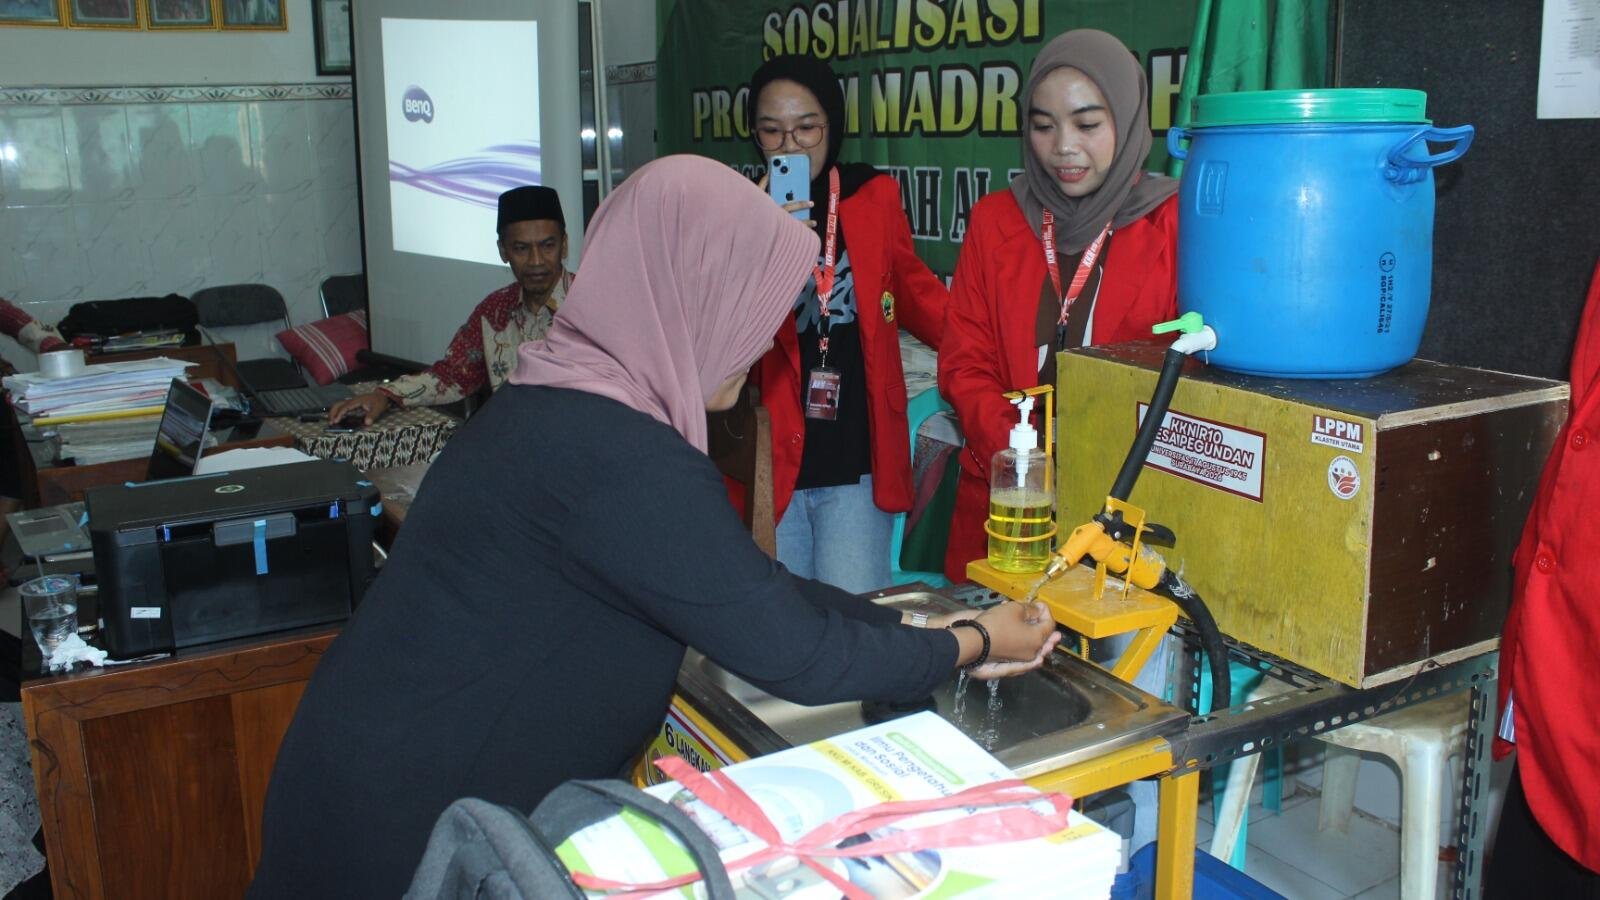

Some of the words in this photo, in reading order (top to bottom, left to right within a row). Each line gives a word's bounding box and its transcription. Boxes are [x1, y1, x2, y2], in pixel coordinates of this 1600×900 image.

[762, 0, 1041, 60] SOSIALISASI
[692, 76, 860, 139] PROM
[871, 54, 1188, 133] MADRH
[1314, 435, 1340, 446] KLASTER
[1341, 441, 1360, 450] UTAMA
[1315, 416, 1361, 441] LPPM
[1155, 427, 1178, 446] ESA
[1179, 434, 1254, 468] PEGUNDAN
[664, 721, 675, 748] 6
